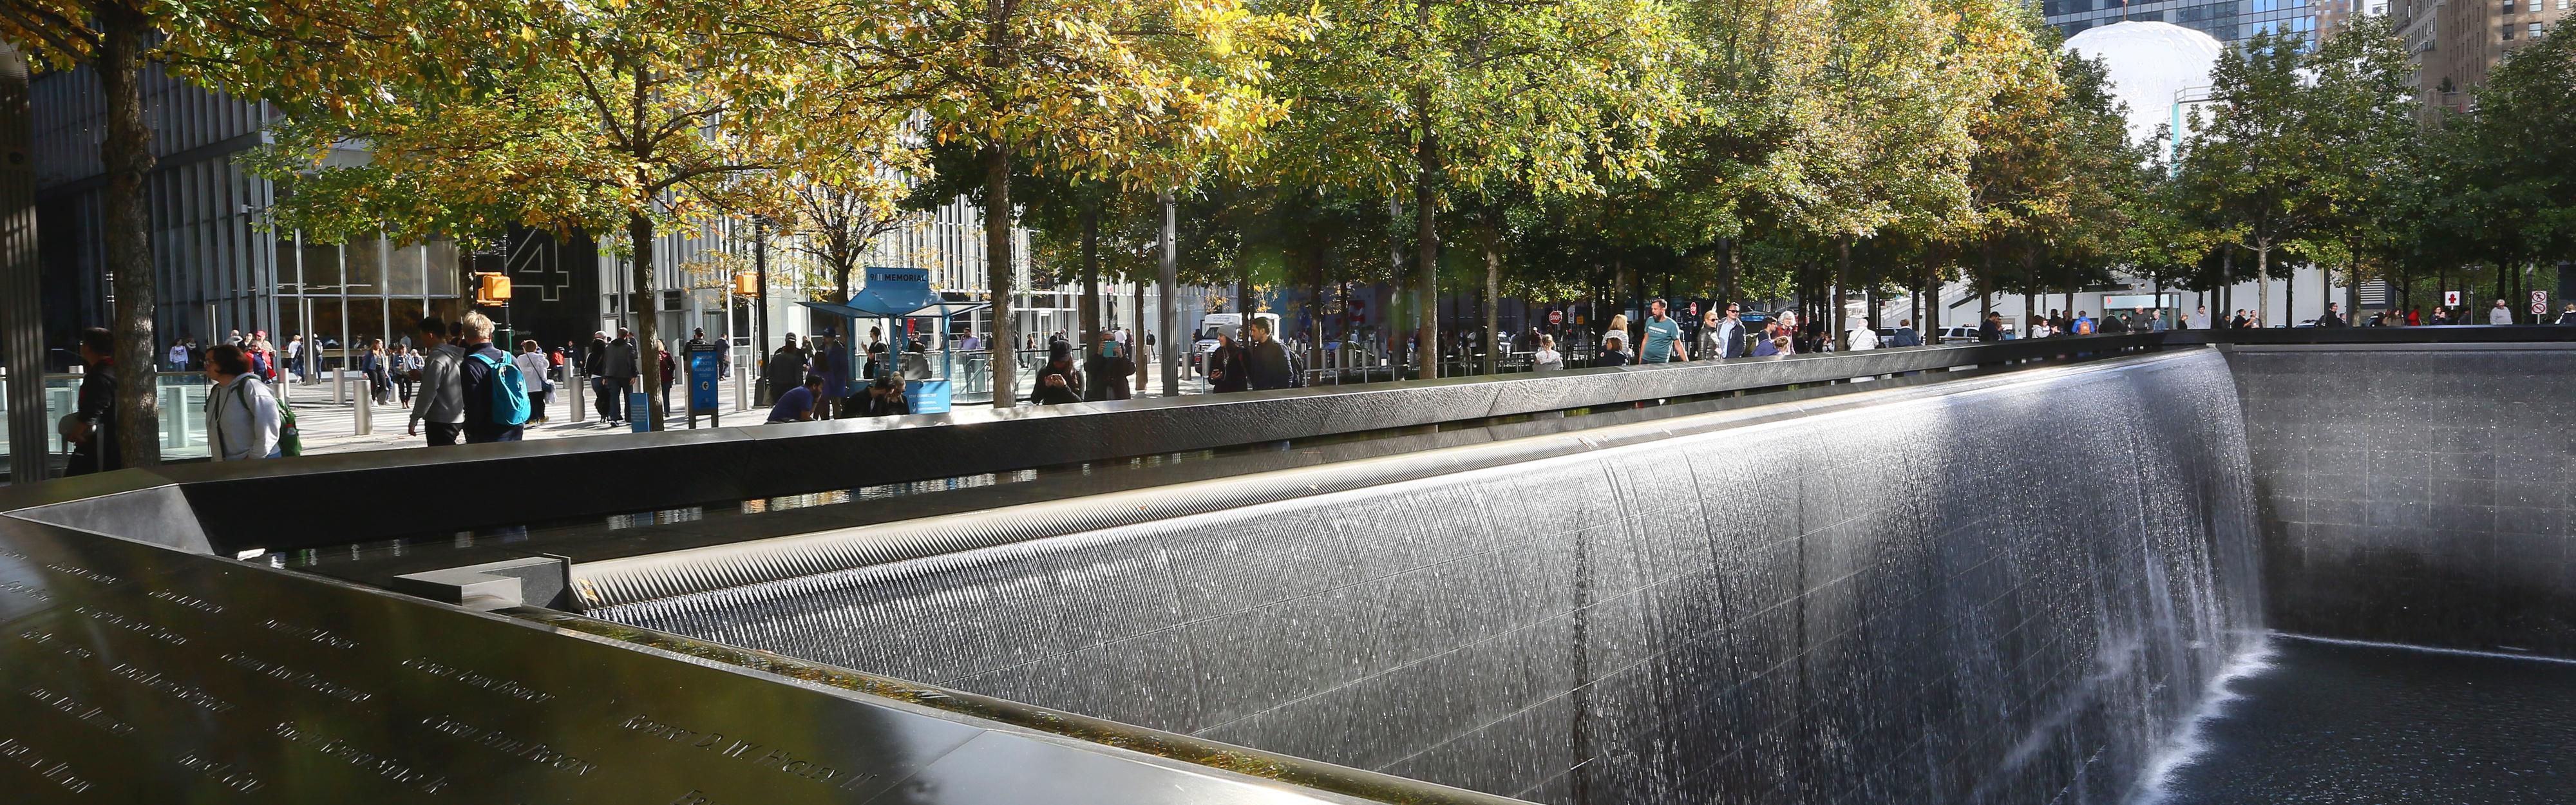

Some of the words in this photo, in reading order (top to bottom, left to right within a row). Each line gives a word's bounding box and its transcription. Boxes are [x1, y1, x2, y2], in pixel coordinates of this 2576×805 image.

[619, 713, 697, 743] ROBERT
[691, 732, 723, 752] D.
[722, 739, 762, 760] W.
[753, 748, 845, 783] HIGLEY
[840, 773, 878, 791] II
